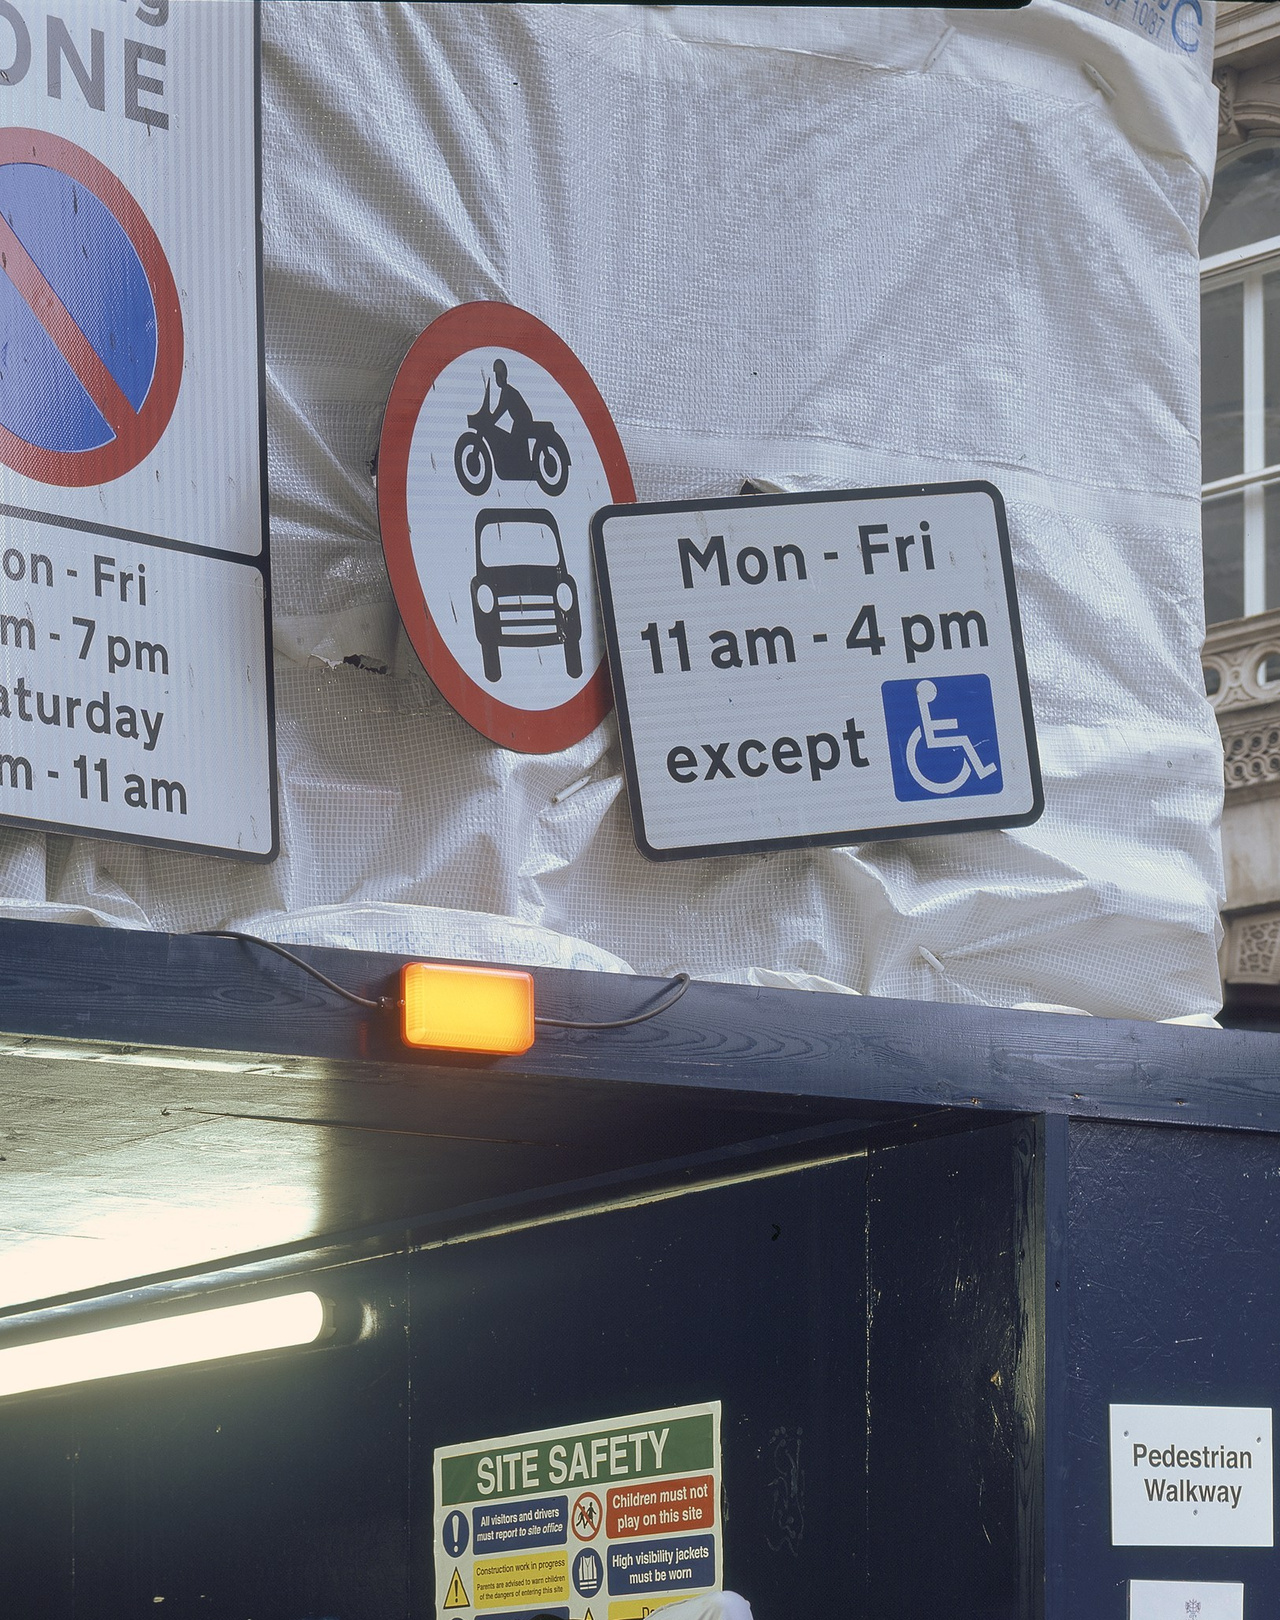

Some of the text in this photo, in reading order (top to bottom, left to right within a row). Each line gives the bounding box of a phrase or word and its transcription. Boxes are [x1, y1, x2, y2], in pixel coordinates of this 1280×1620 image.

[677, 534, 807, 589] Mon
[857, 521, 936, 575] Fri
[93, 554, 147, 606] Fri
[666, 717, 870, 783] except
[477, 1428, 670, 1495] SITE SAFETY
[1132, 1443, 1253, 1469] Pedestrian
[612, 1483, 708, 1509] Children must not
[1144, 1478, 1243, 1510] Walkway
[480, 1508, 560, 1527] All visitors and drivers
[617, 1506, 703, 1533] play on this site
[476, 1522, 564, 1542] must report to site office
[476, 1559, 566, 1576] Construction work in progress
[612, 1546, 710, 1570] High visibility jackets
[476, 1583, 495, 1591] Parents
[505, 1579, 525, 1588] advised
[544, 1575, 566, 1584] children
[629, 1568, 692, 1585] must be worn
[479, 1593, 485, 1601] of
[485, 1592, 494, 1600] the
[494, 1591, 514, 1600] dangers
[521, 1588, 542, 1597] entering
[542, 1586, 553, 1594] this
[553, 1585, 564, 1593] site
